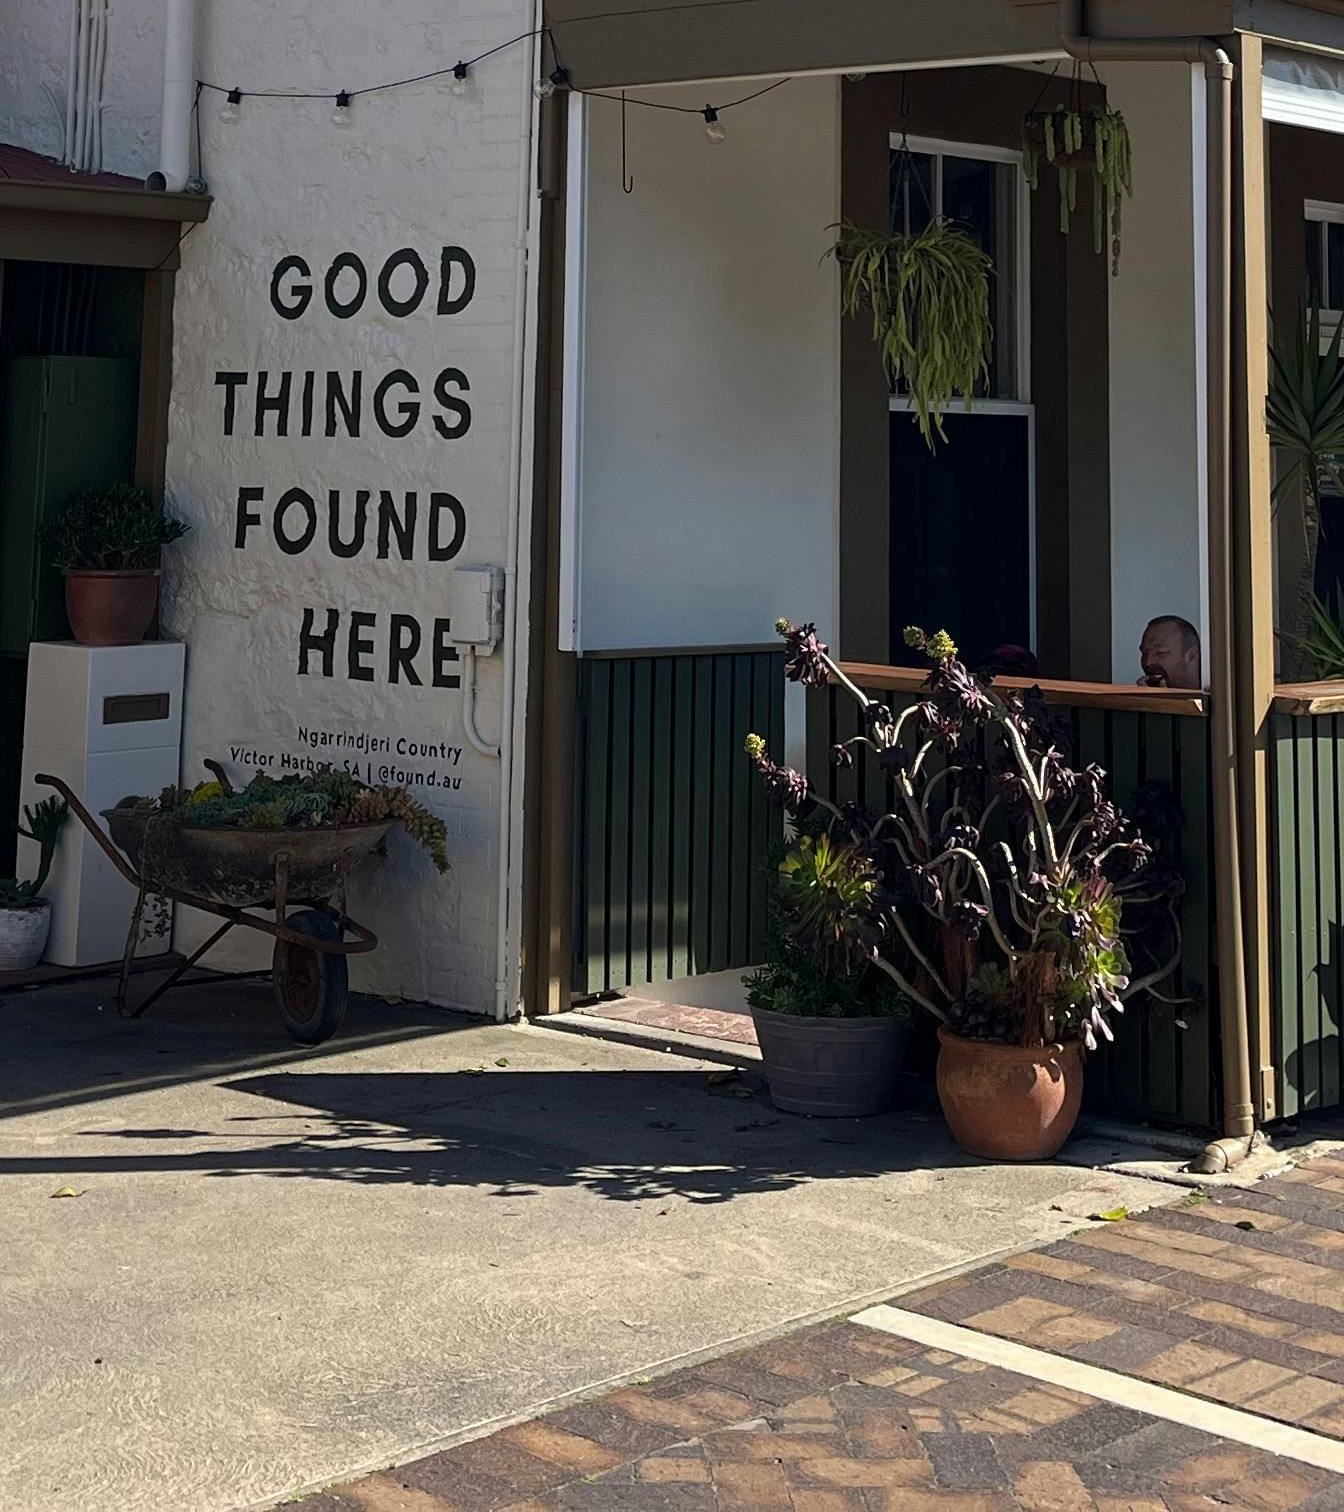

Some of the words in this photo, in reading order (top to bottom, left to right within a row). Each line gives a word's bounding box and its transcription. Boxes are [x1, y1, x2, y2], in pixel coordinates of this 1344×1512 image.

[270, 245, 476, 320] GOOD
[214, 367, 472, 439] THINGS
[234, 486, 467, 561] FOUND
[297, 607, 461, 689] HERE
[230, 747, 275, 766] Victor
[378, 765, 462, 790] @found.au
[298, 726, 391, 754] Ngarrindjeri
[396, 737, 463, 765] Country
